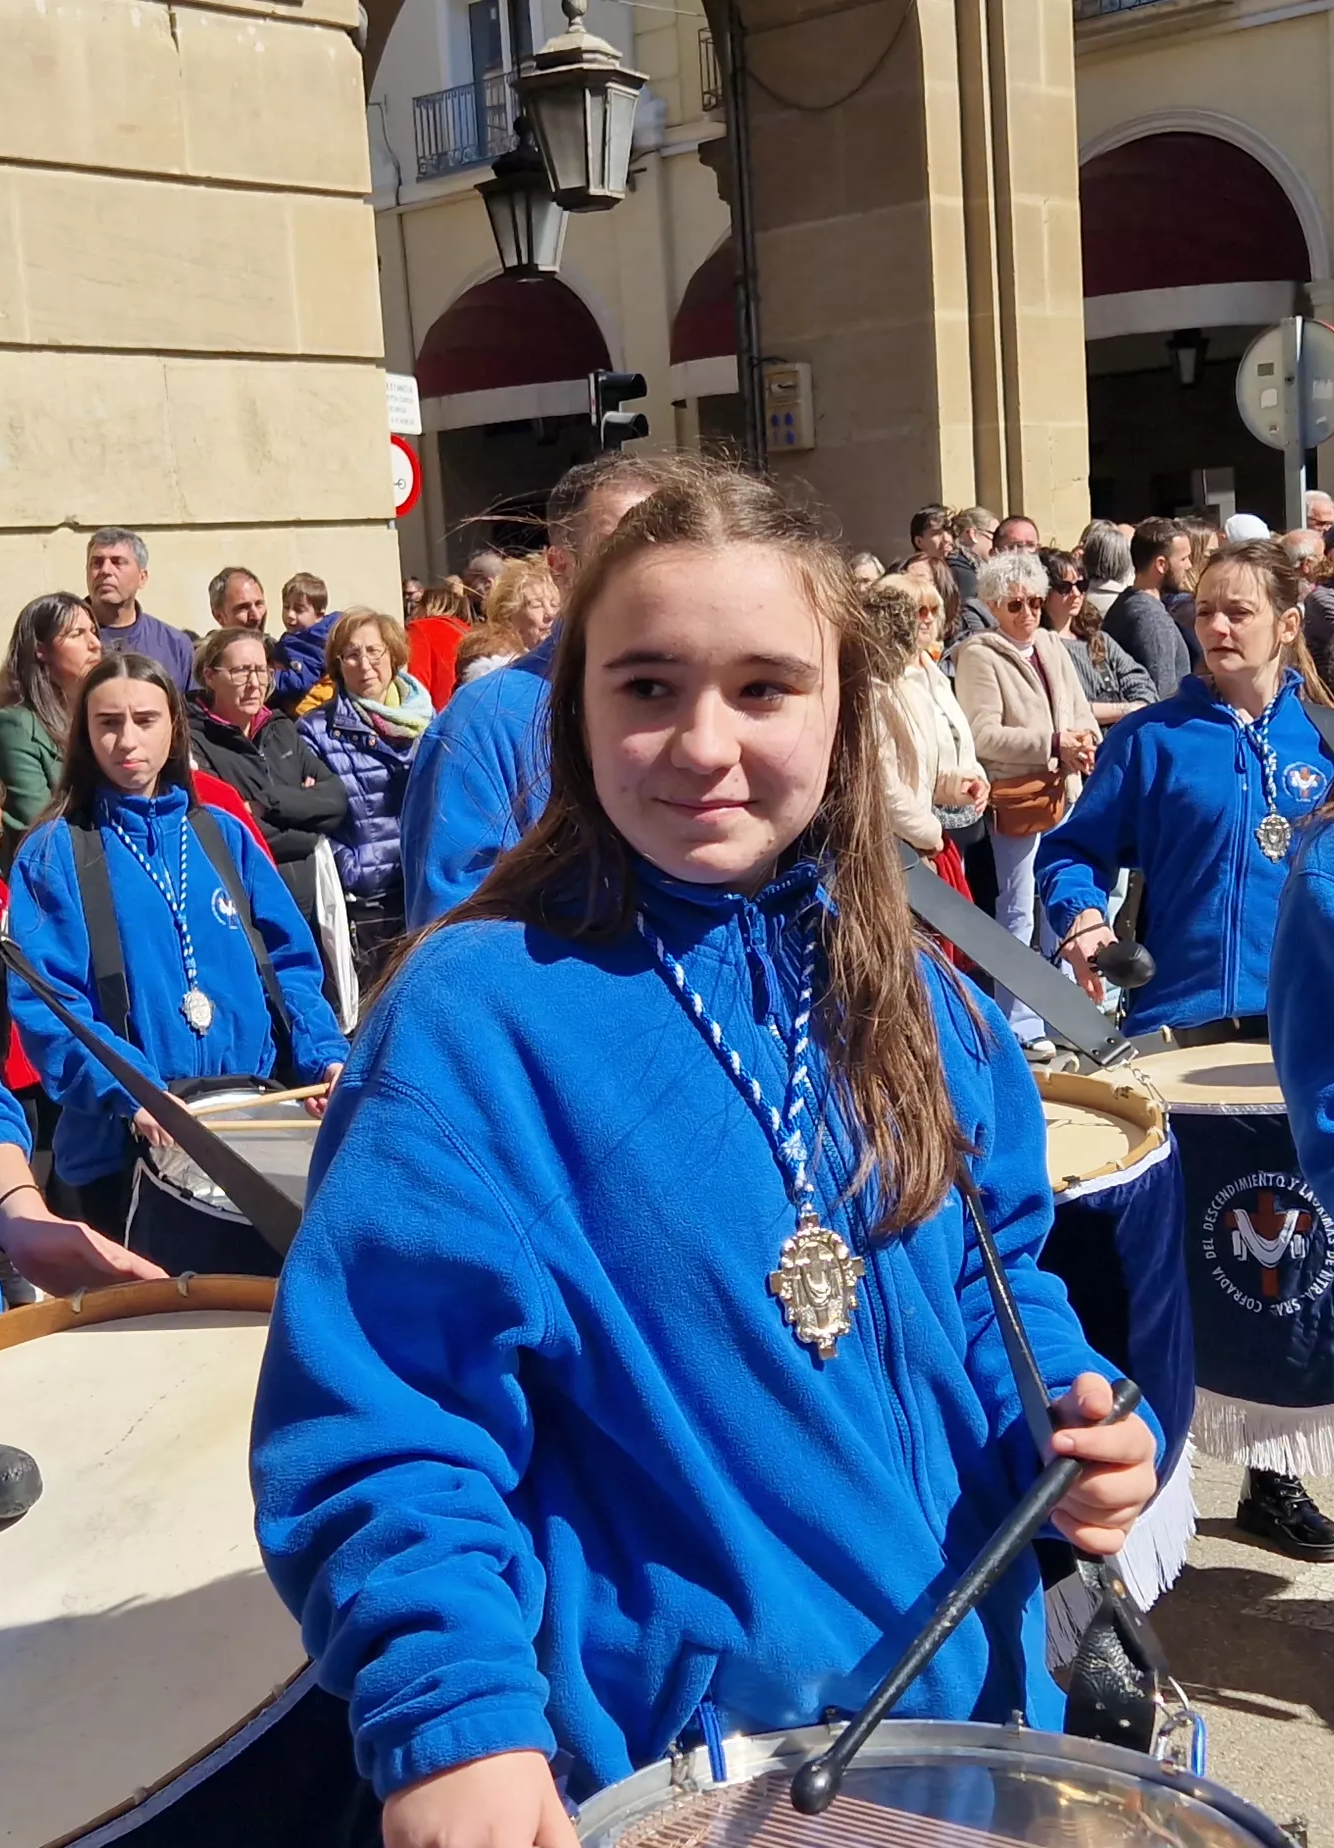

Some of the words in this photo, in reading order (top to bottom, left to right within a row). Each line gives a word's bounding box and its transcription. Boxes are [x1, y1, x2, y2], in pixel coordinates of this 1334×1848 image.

[1287, 1177, 1300, 1191] Y
[1202, 1173, 1286, 1232] DESCENDIMIENTO
[1202, 1238, 1217, 1260] DEL
